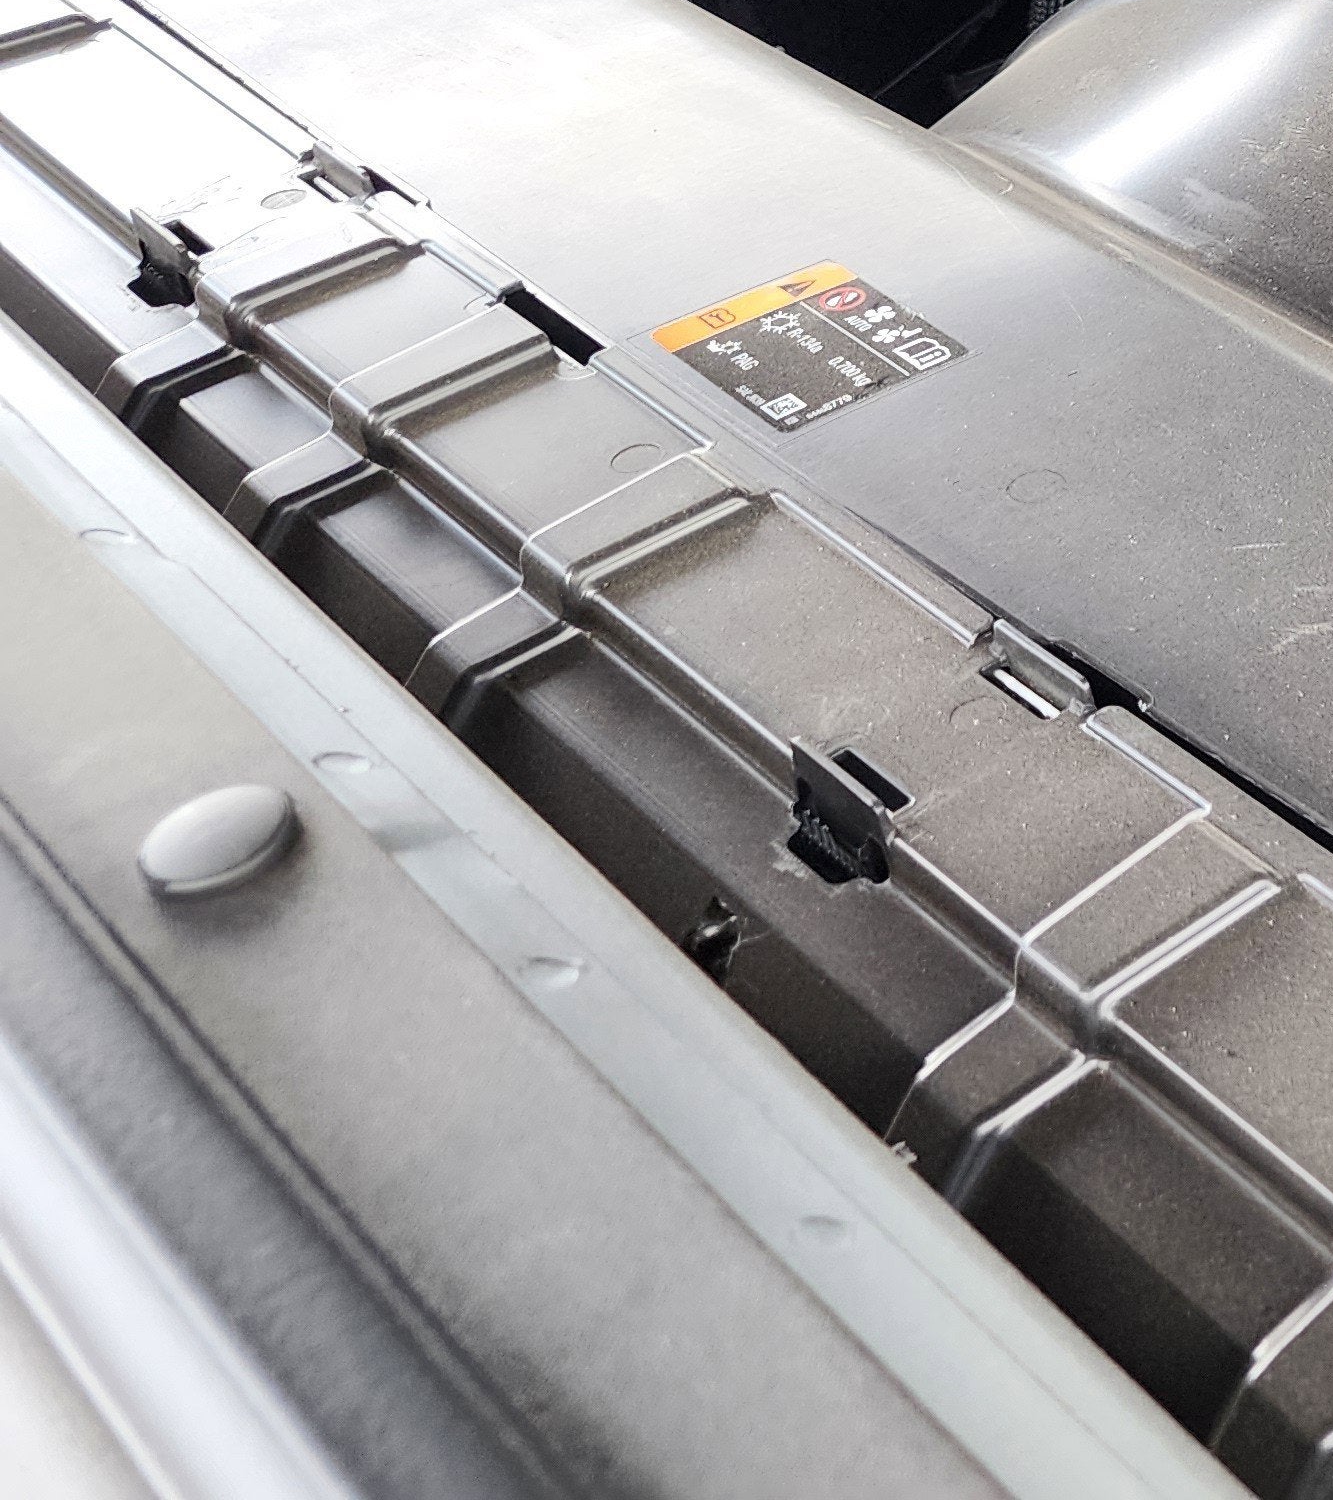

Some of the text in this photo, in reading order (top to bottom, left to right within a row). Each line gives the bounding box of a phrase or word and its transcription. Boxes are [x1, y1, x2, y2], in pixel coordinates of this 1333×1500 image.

[844, 315, 873, 332] AUTO
[786, 327, 824, 354] R-134a
[730, 352, 760, 371] PAG
